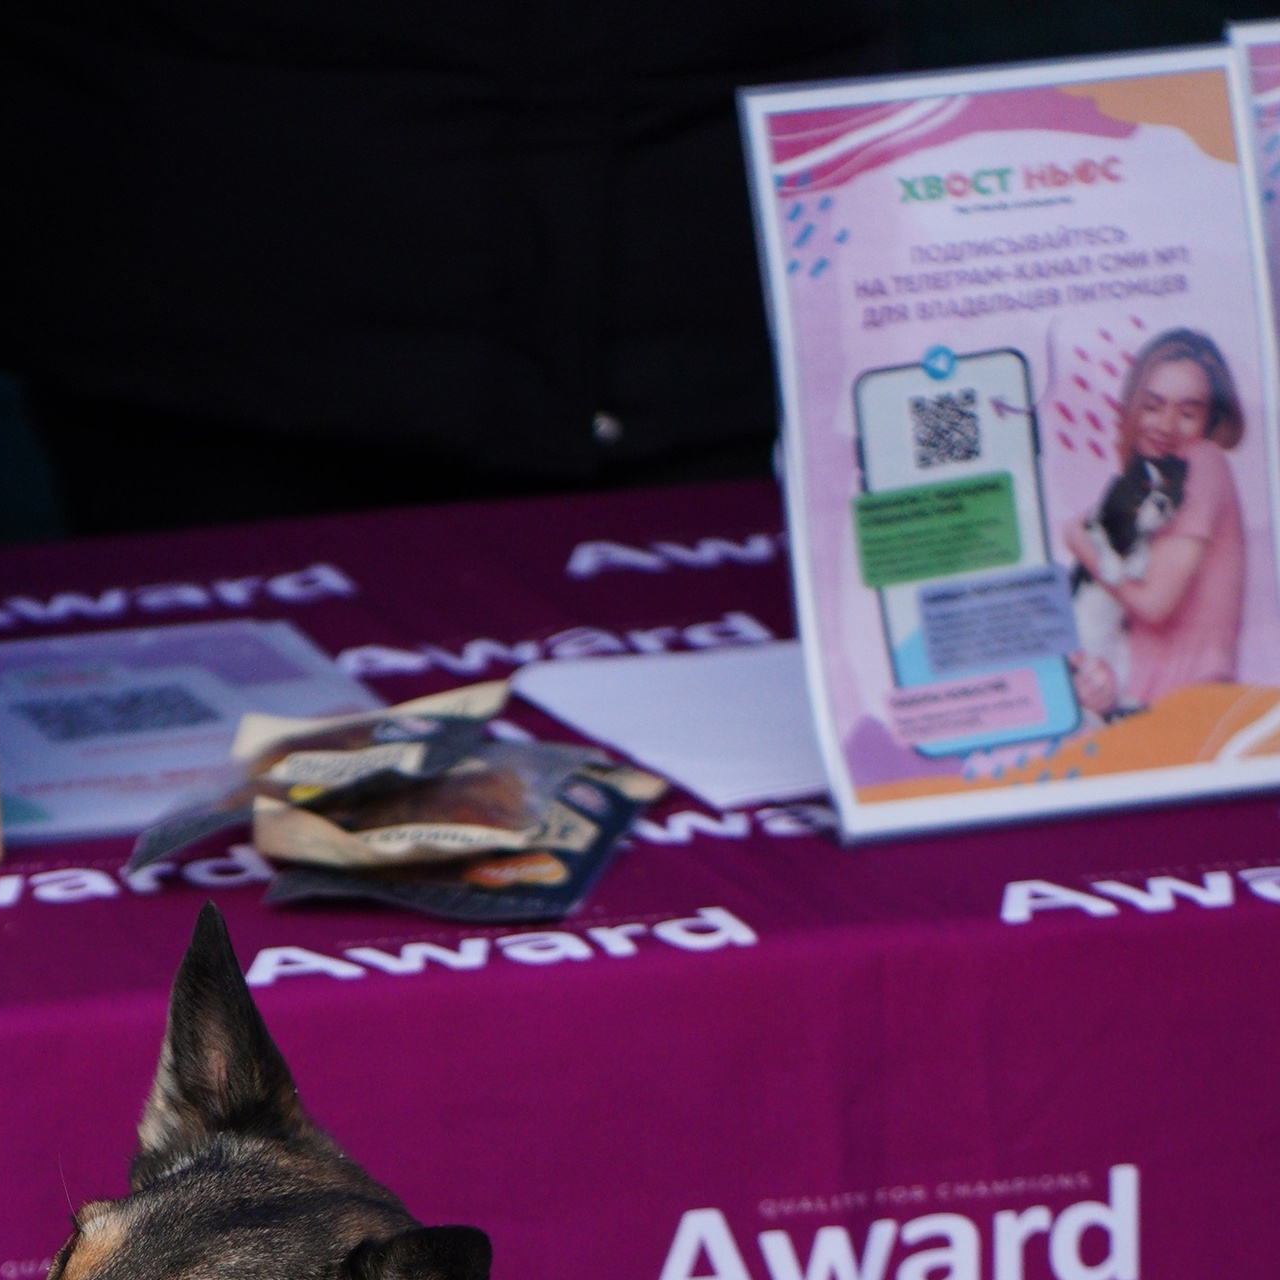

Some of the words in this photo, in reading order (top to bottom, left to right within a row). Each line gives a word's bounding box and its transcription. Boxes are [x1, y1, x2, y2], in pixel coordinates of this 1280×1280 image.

[898, 166, 1012, 203] ХВОСТ
[854, 277, 888, 299] НА
[244, 906, 757, 986] Award
